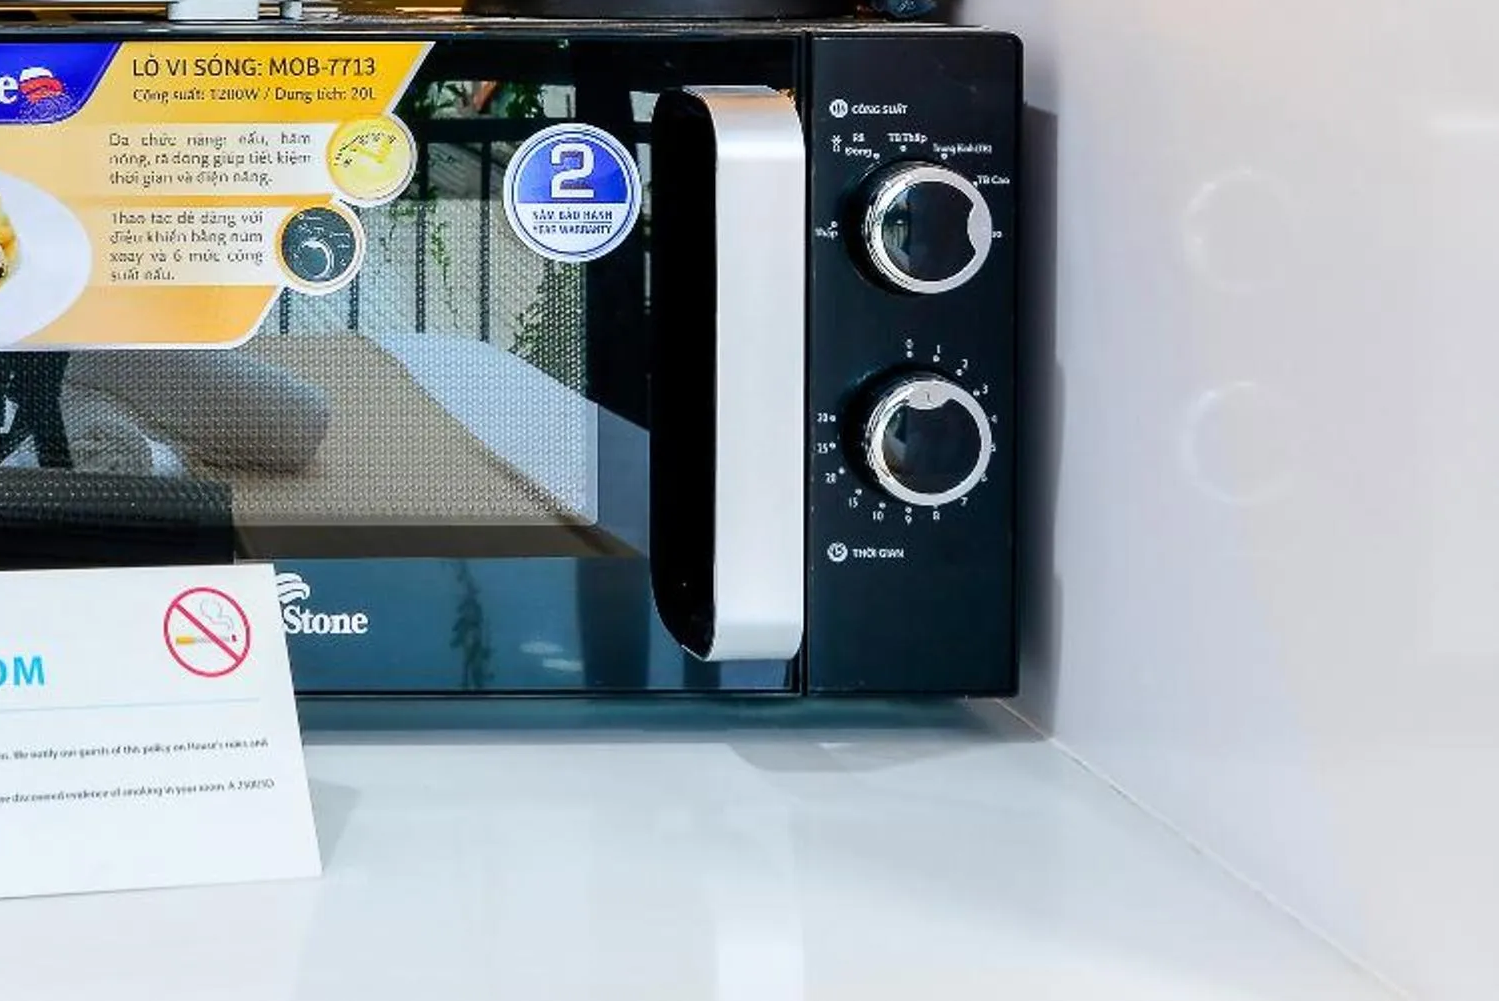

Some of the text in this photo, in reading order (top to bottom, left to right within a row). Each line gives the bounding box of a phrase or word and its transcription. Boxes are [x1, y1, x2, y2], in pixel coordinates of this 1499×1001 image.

[133, 53, 376, 77] LÒ VI SÓNG: MOB-7713
[274, 87, 313, 104] Dung
[350, 87, 377, 101] 20L
[550, 142, 595, 199] 2
[872, 511, 884, 521] 10
[283, 604, 369, 634] Stone
